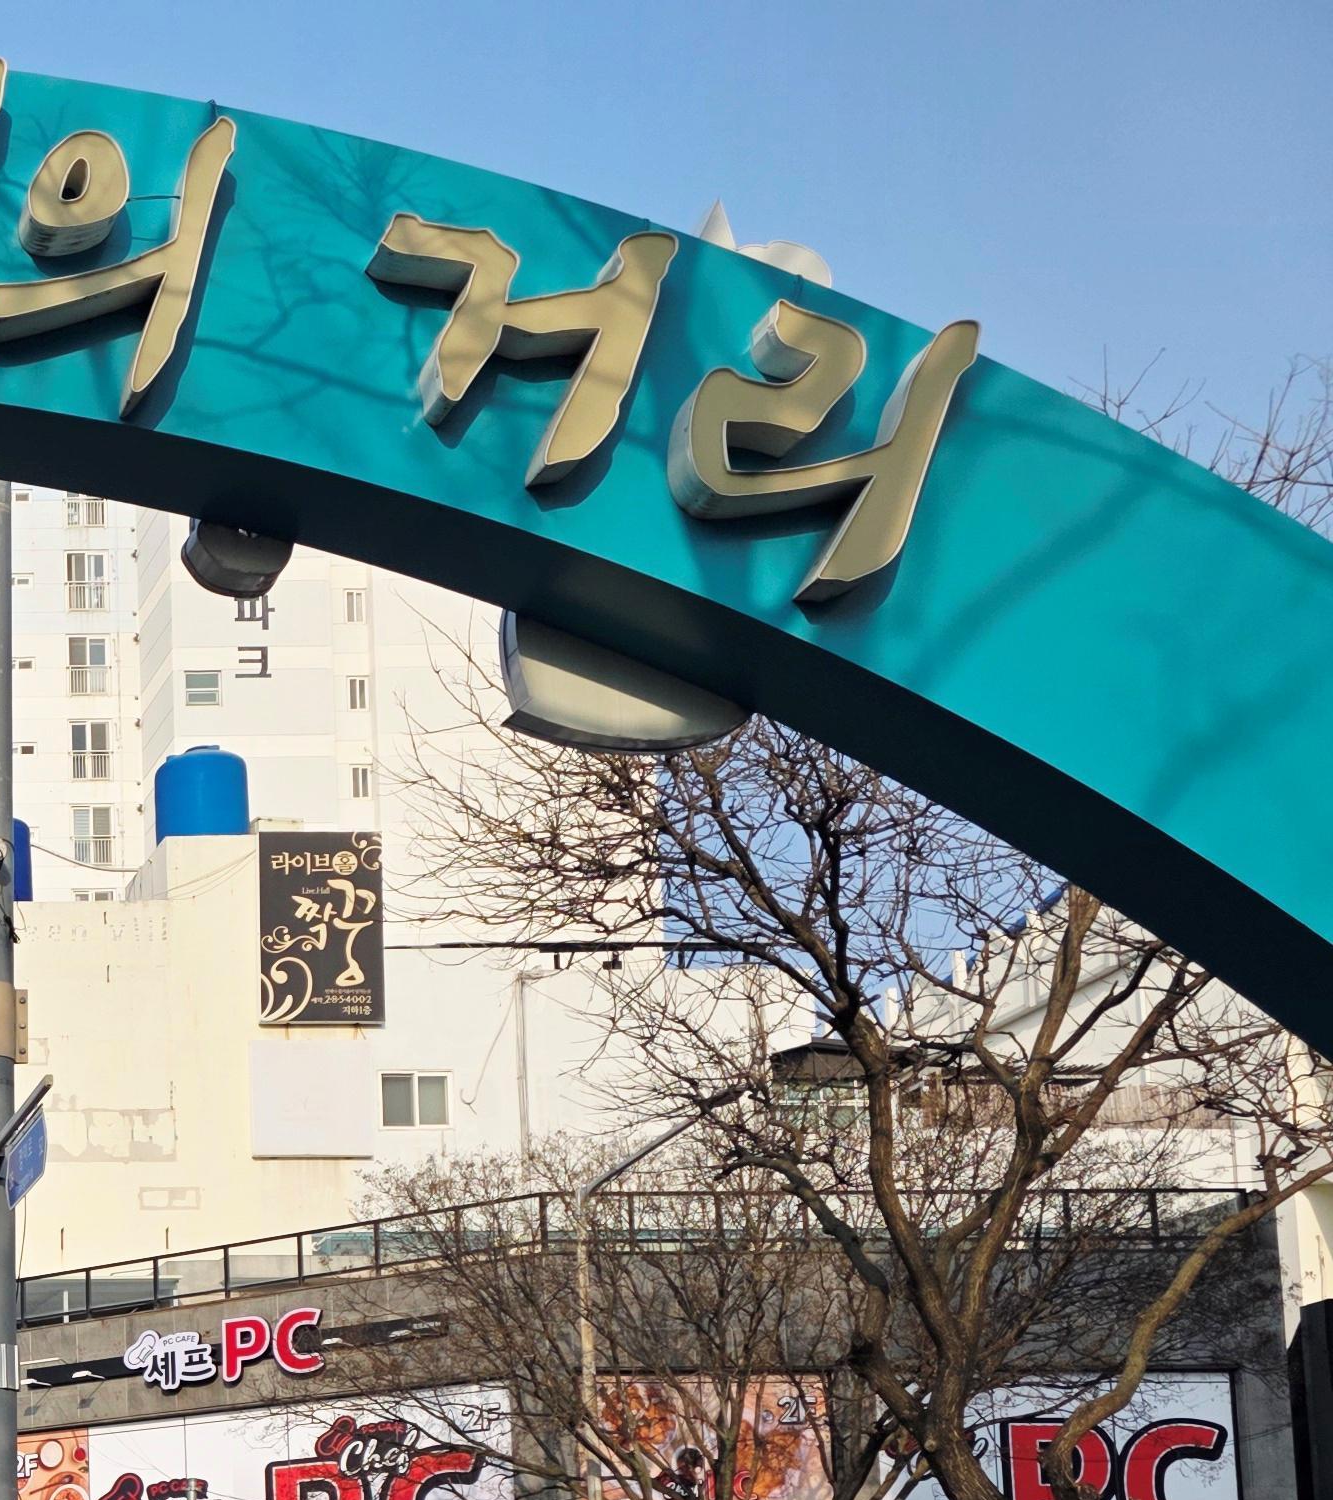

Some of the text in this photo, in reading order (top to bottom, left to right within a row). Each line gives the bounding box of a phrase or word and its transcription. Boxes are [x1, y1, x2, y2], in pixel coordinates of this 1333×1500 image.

[366, 212, 980, 600] 거리
[271, 851, 358, 875] 라이브홀
[148, 1308, 325, 1386] 셰프 PC
